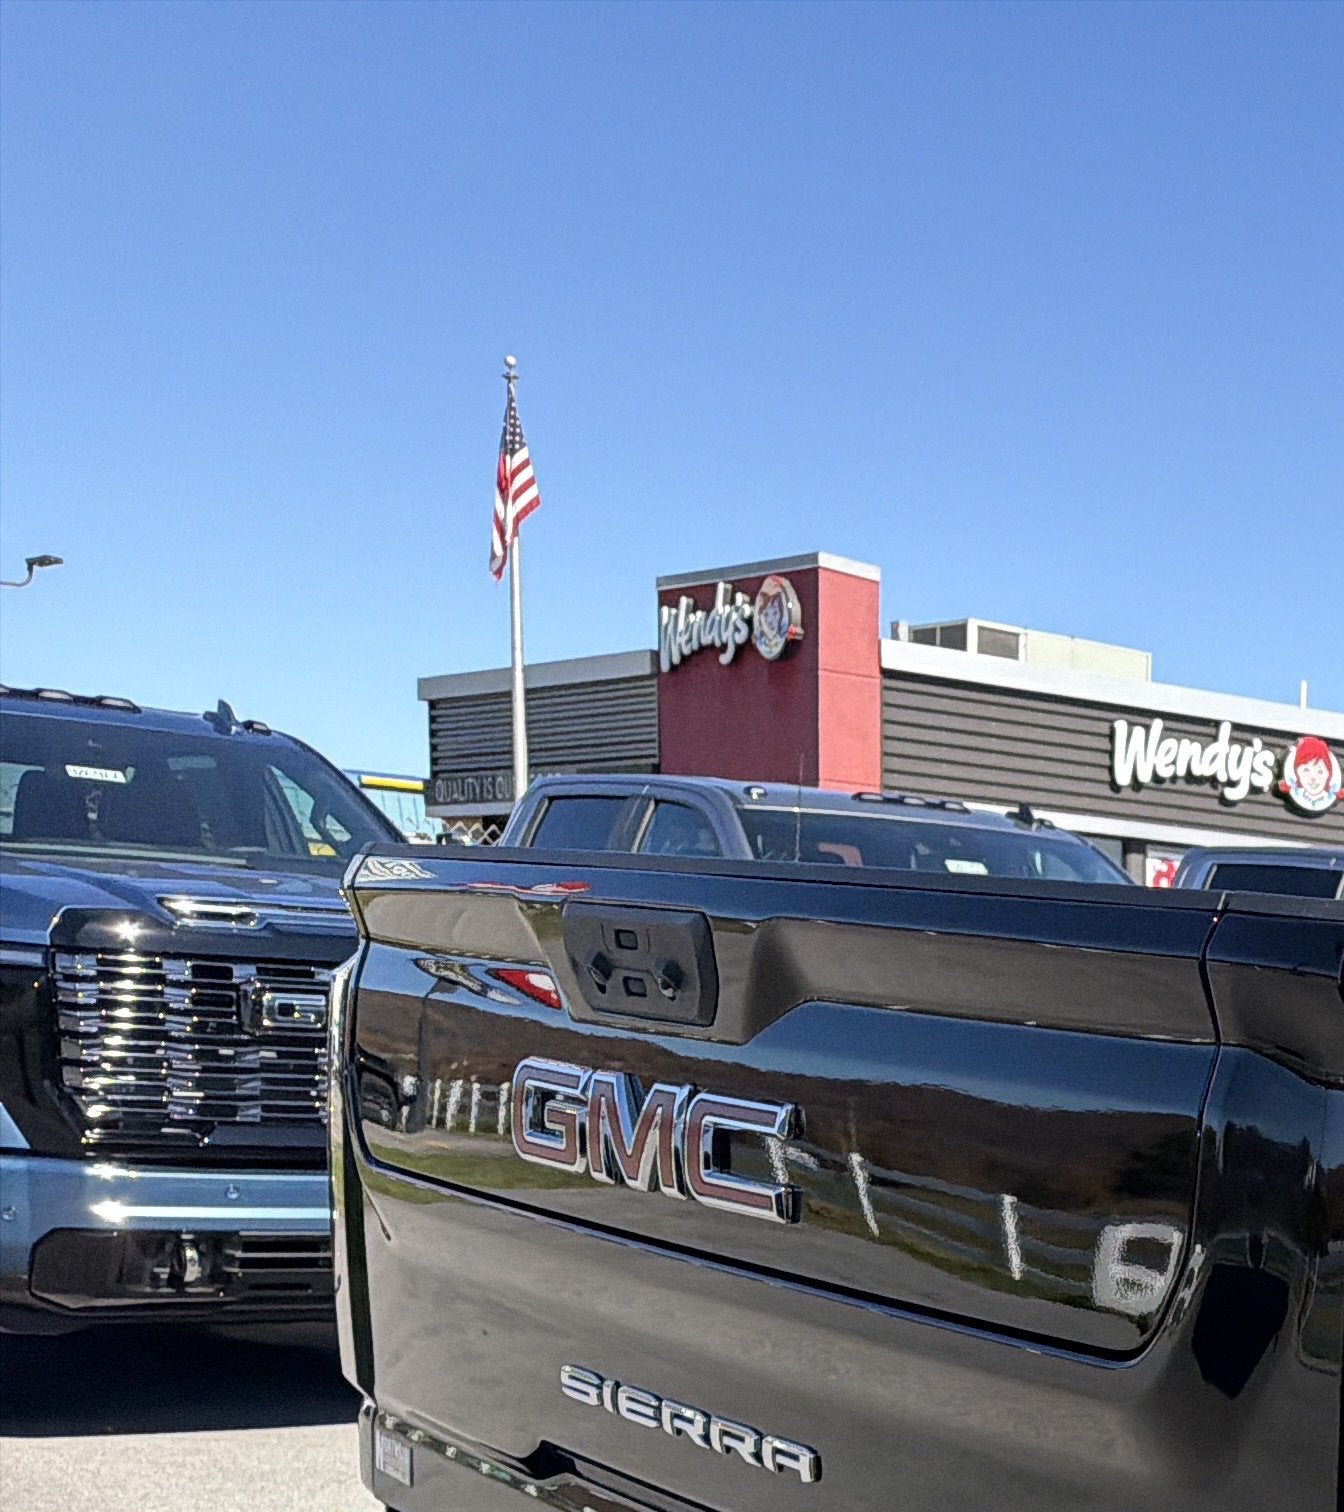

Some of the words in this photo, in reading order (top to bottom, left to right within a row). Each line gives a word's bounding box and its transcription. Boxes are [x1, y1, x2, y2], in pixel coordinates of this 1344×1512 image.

[660, 581, 750, 673] Wendy's
[435, 777, 480, 802] QUALITY
[482, 777, 493, 799] IS
[496, 775, 516, 799] OU
[1114, 718, 1275, 800] Wendy's
[511, 1056, 802, 1224] GMC
[560, 1364, 822, 1483] SIERRA
